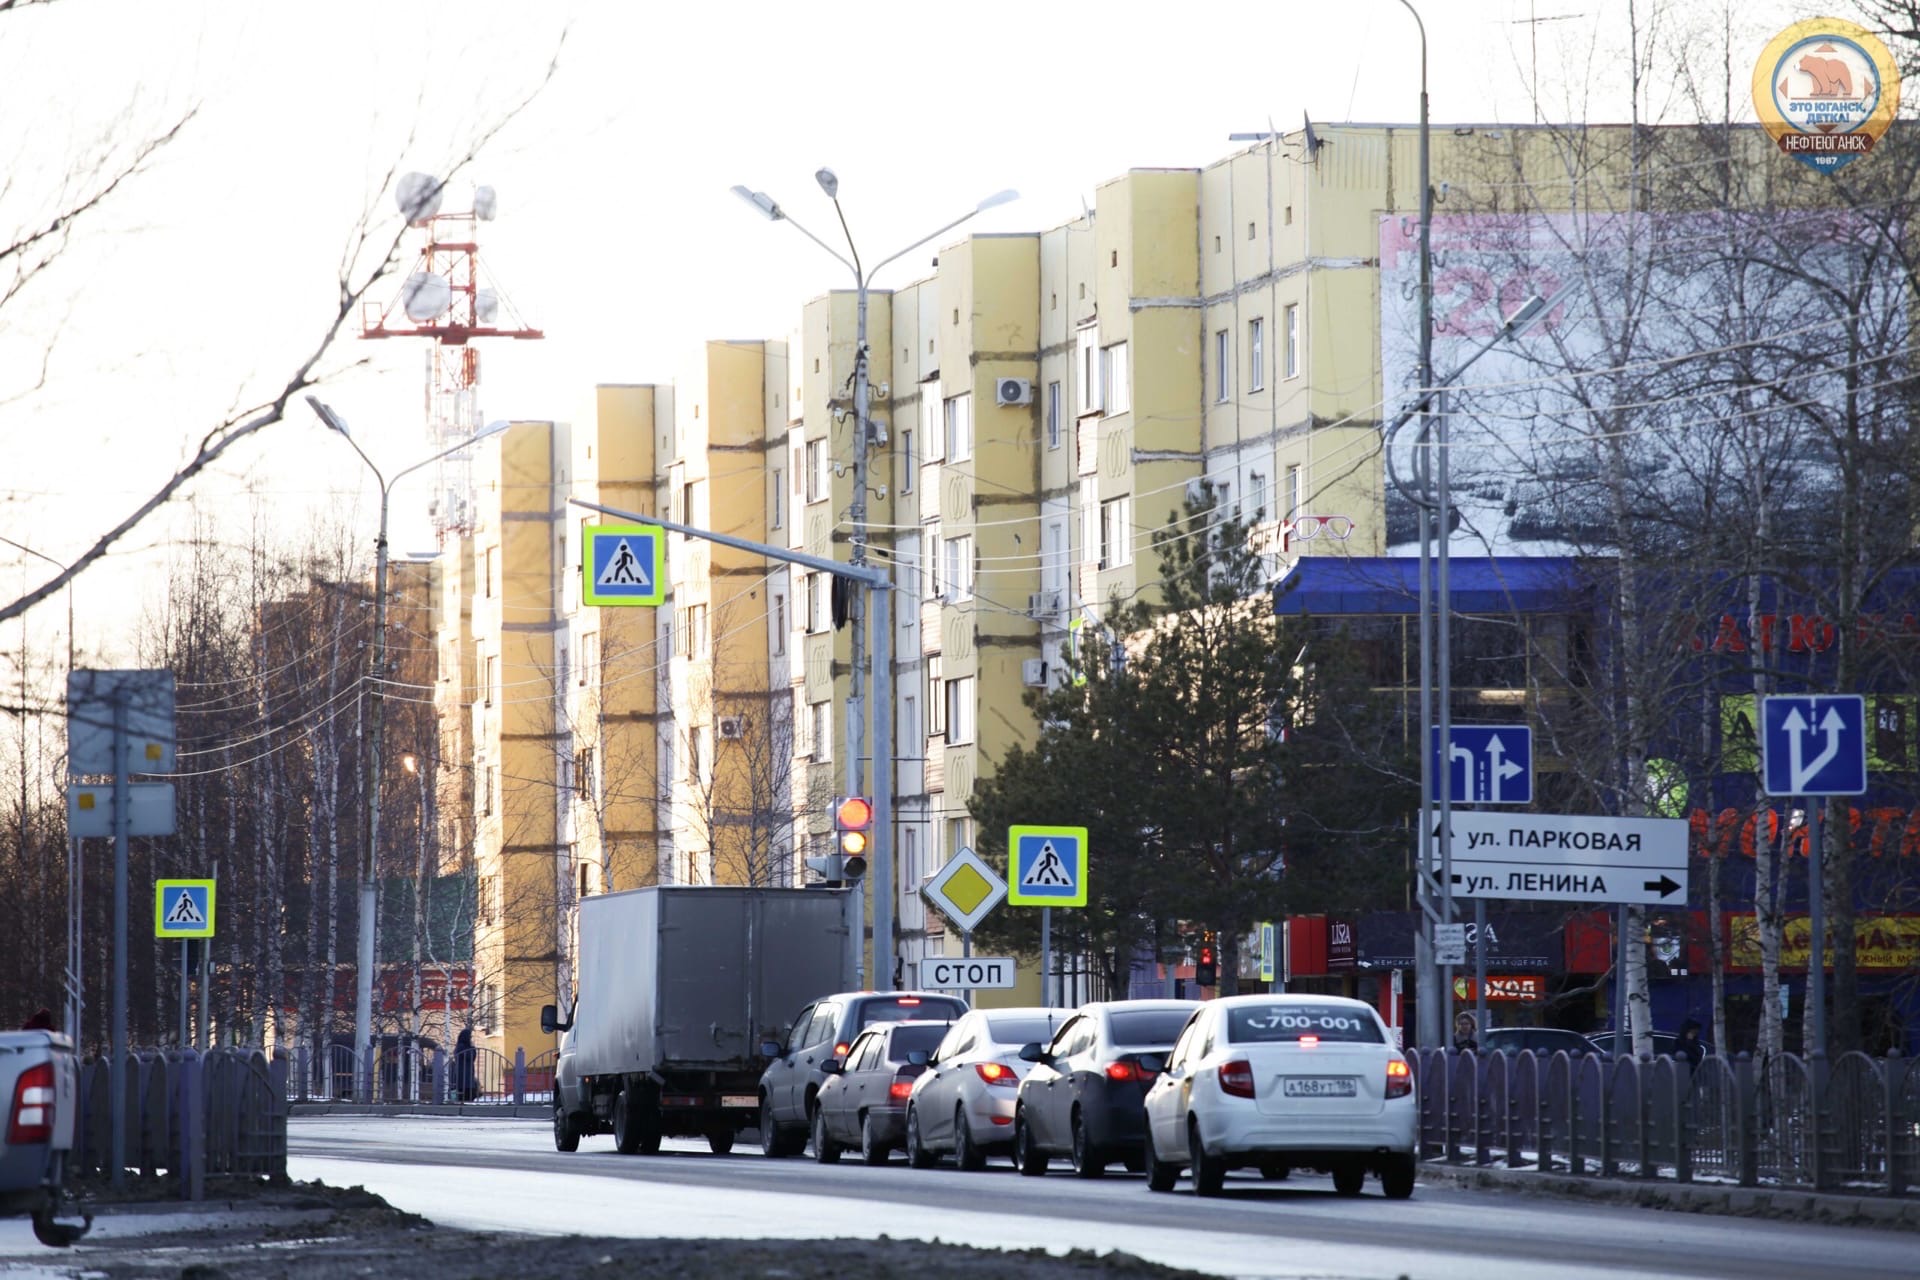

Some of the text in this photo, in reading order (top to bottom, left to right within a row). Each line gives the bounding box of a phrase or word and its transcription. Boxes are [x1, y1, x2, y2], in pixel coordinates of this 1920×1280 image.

[1467, 829, 1642, 851] ул. ПАРКОВАЯ
[1466, 873, 1607, 894] ул. ЛЕНИНА
[934, 964, 1001, 984] СТОП
[1264, 1015, 1361, 1031] 700-001
